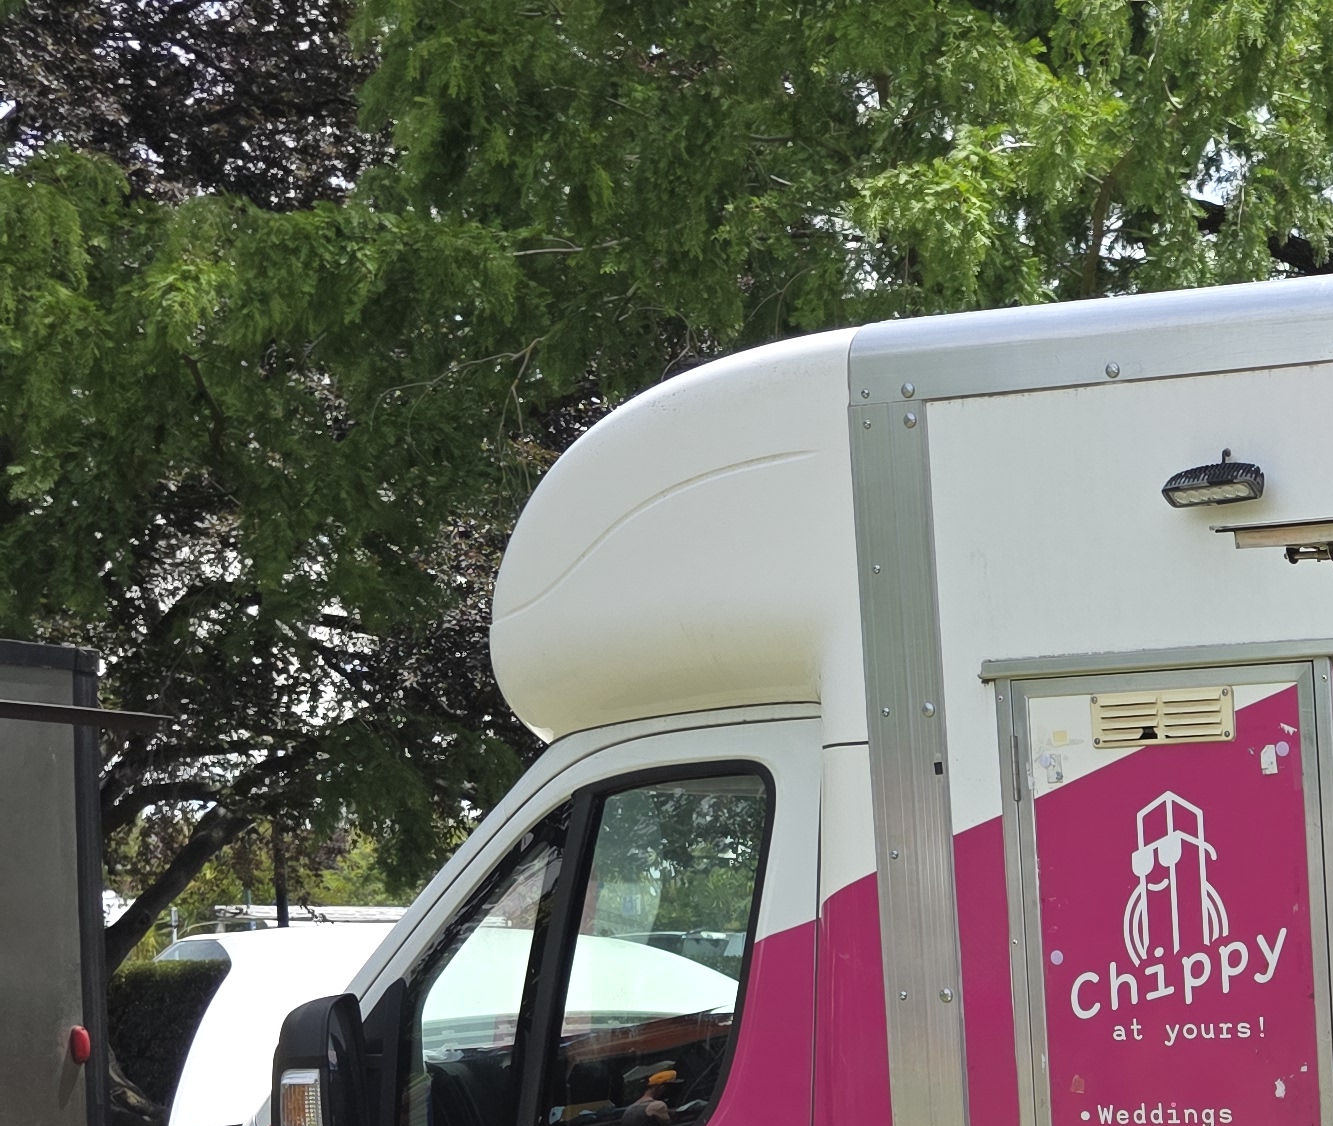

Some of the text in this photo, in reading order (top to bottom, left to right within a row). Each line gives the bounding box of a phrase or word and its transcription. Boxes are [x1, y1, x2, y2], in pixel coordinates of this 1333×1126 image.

[1070, 927, 1287, 1019] Chippy
[1112, 1017, 1266, 1046] at yours!
